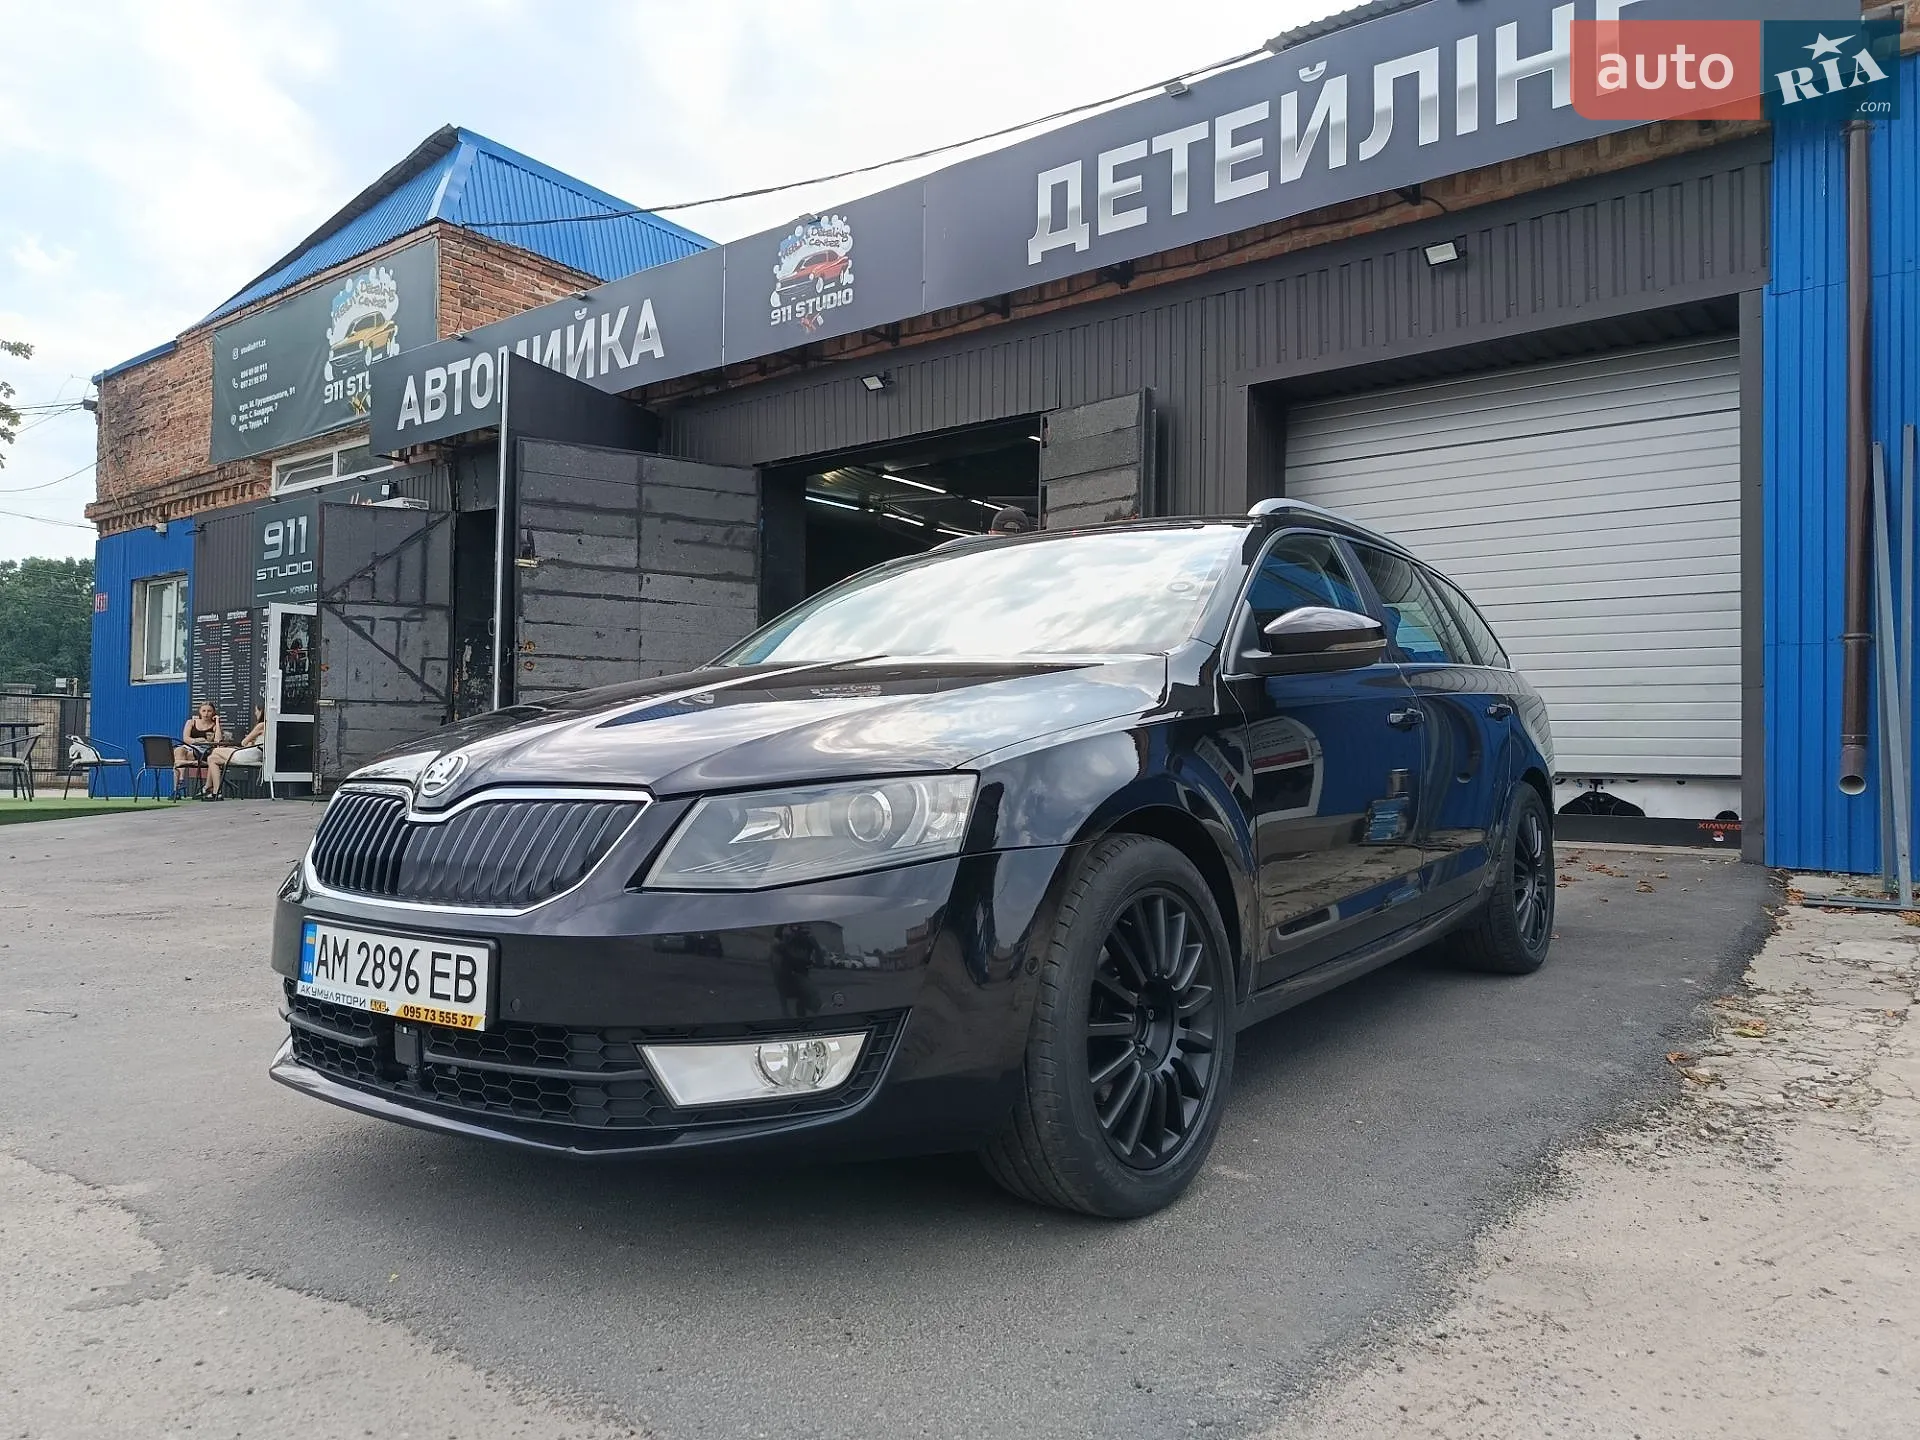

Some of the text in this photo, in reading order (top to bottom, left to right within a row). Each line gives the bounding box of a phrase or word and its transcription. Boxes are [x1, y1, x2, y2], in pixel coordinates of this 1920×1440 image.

[770, 288, 854, 326] 911 STUDIO
[323, 382, 344, 404] 911
[263, 515, 308, 561] 911
[256, 560, 313, 581] STUDIO
[303, 960, 313, 976] UA
[315, 934, 477, 1003] AM 2896 EB
[300, 985, 366, 1008] АКУМУЛЯТОРИ
[403, 1005, 474, 1027] 095 73 555 37
